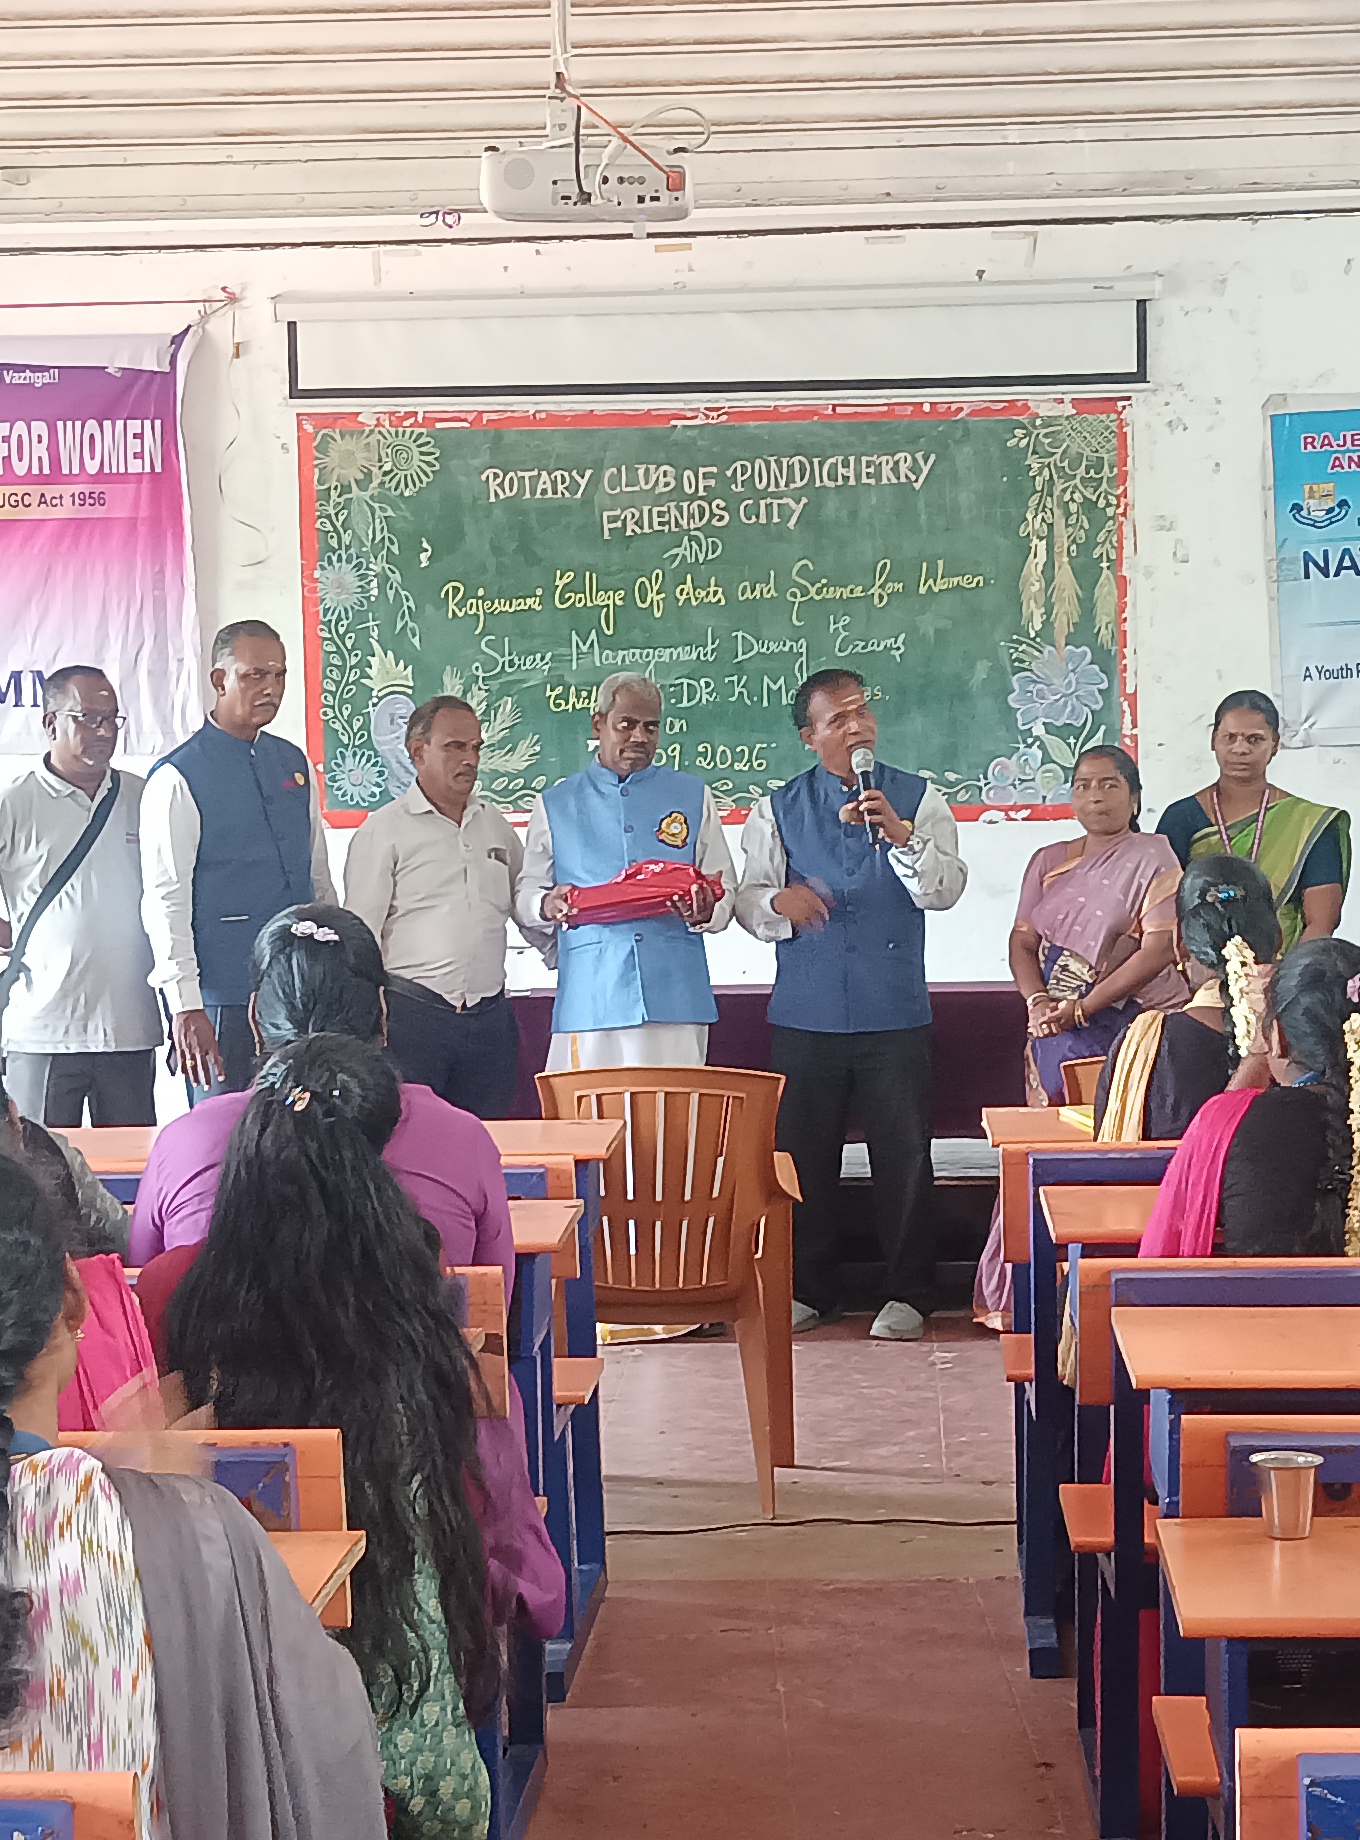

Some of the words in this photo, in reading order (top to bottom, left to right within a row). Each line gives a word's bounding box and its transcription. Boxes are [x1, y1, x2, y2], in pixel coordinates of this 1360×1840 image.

[56, 418, 163, 475] WOMEN
[37, 491, 64, 509] Act
[70, 491, 107, 508] 1956
[481, 467, 594, 503] ROTARY
[603, 462, 676, 496] CLUB
[683, 465, 718, 496] OF
[726, 450, 936, 493] PONDICHERRY
[602, 498, 730, 540] FRIENDS
[739, 496, 809, 530] CITY
[662, 530, 723, 569] AND
[440, 579, 544, 636] Rajeswari
[554, 569, 625, 635] College
[635, 567, 665, 618] Of
[675, 573, 727, 608] Arts
[738, 568, 778, 601] and
[786, 557, 866, 627] Science
[866, 557, 905, 608] for
[472, 633, 552, 690] Stress
[571, 627, 721, 684] Management
[732, 630, 808, 686] During
[828, 613, 907, 664] Exams
[1302, 667, 1313, 681] A
[1314, 662, 1354, 681] Youth
